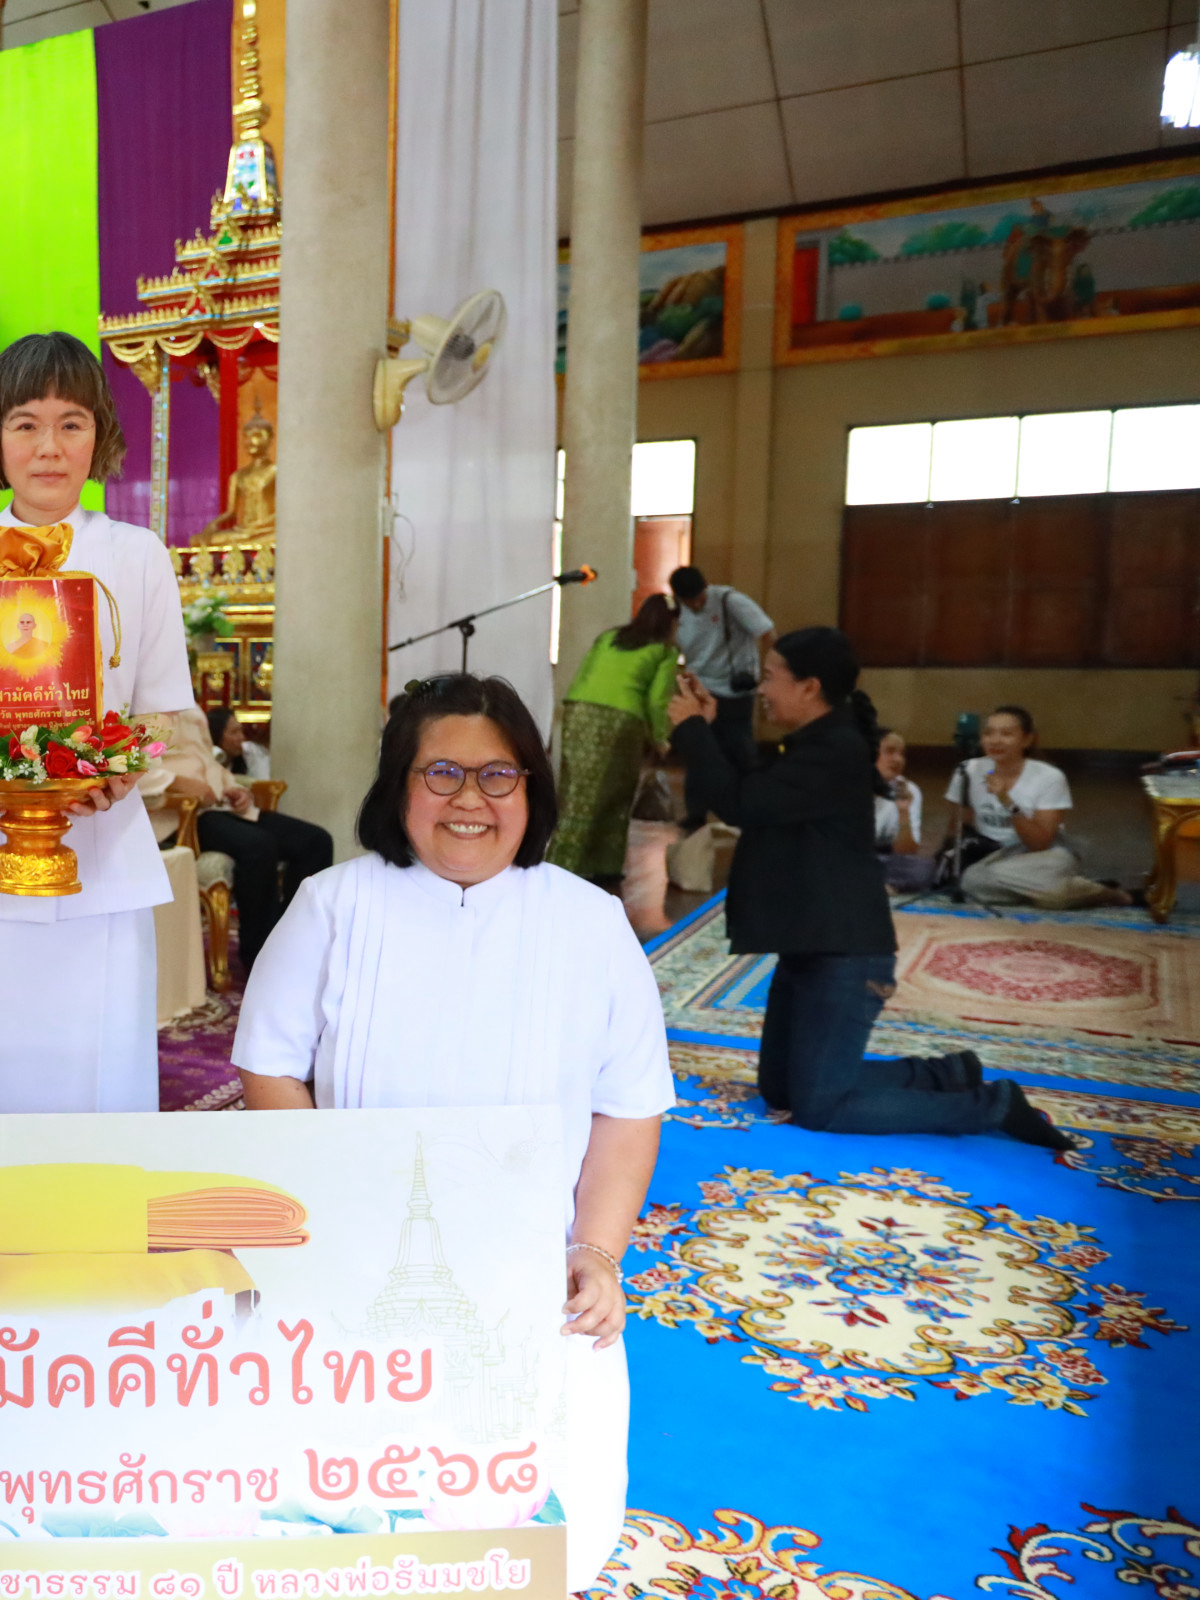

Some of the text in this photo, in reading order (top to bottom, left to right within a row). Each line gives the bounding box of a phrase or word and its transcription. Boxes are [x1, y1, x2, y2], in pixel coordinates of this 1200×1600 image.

[0, 1453, 279, 1524] พุทธศักราช
[303, 1441, 538, 1500] ๒๕๖๘
[153, 1574, 201, 1597] ๘๑
[217, 1562, 238, 1595] ปี
[255, 1552, 526, 1595] หลวงพ่อธัมมชโย
